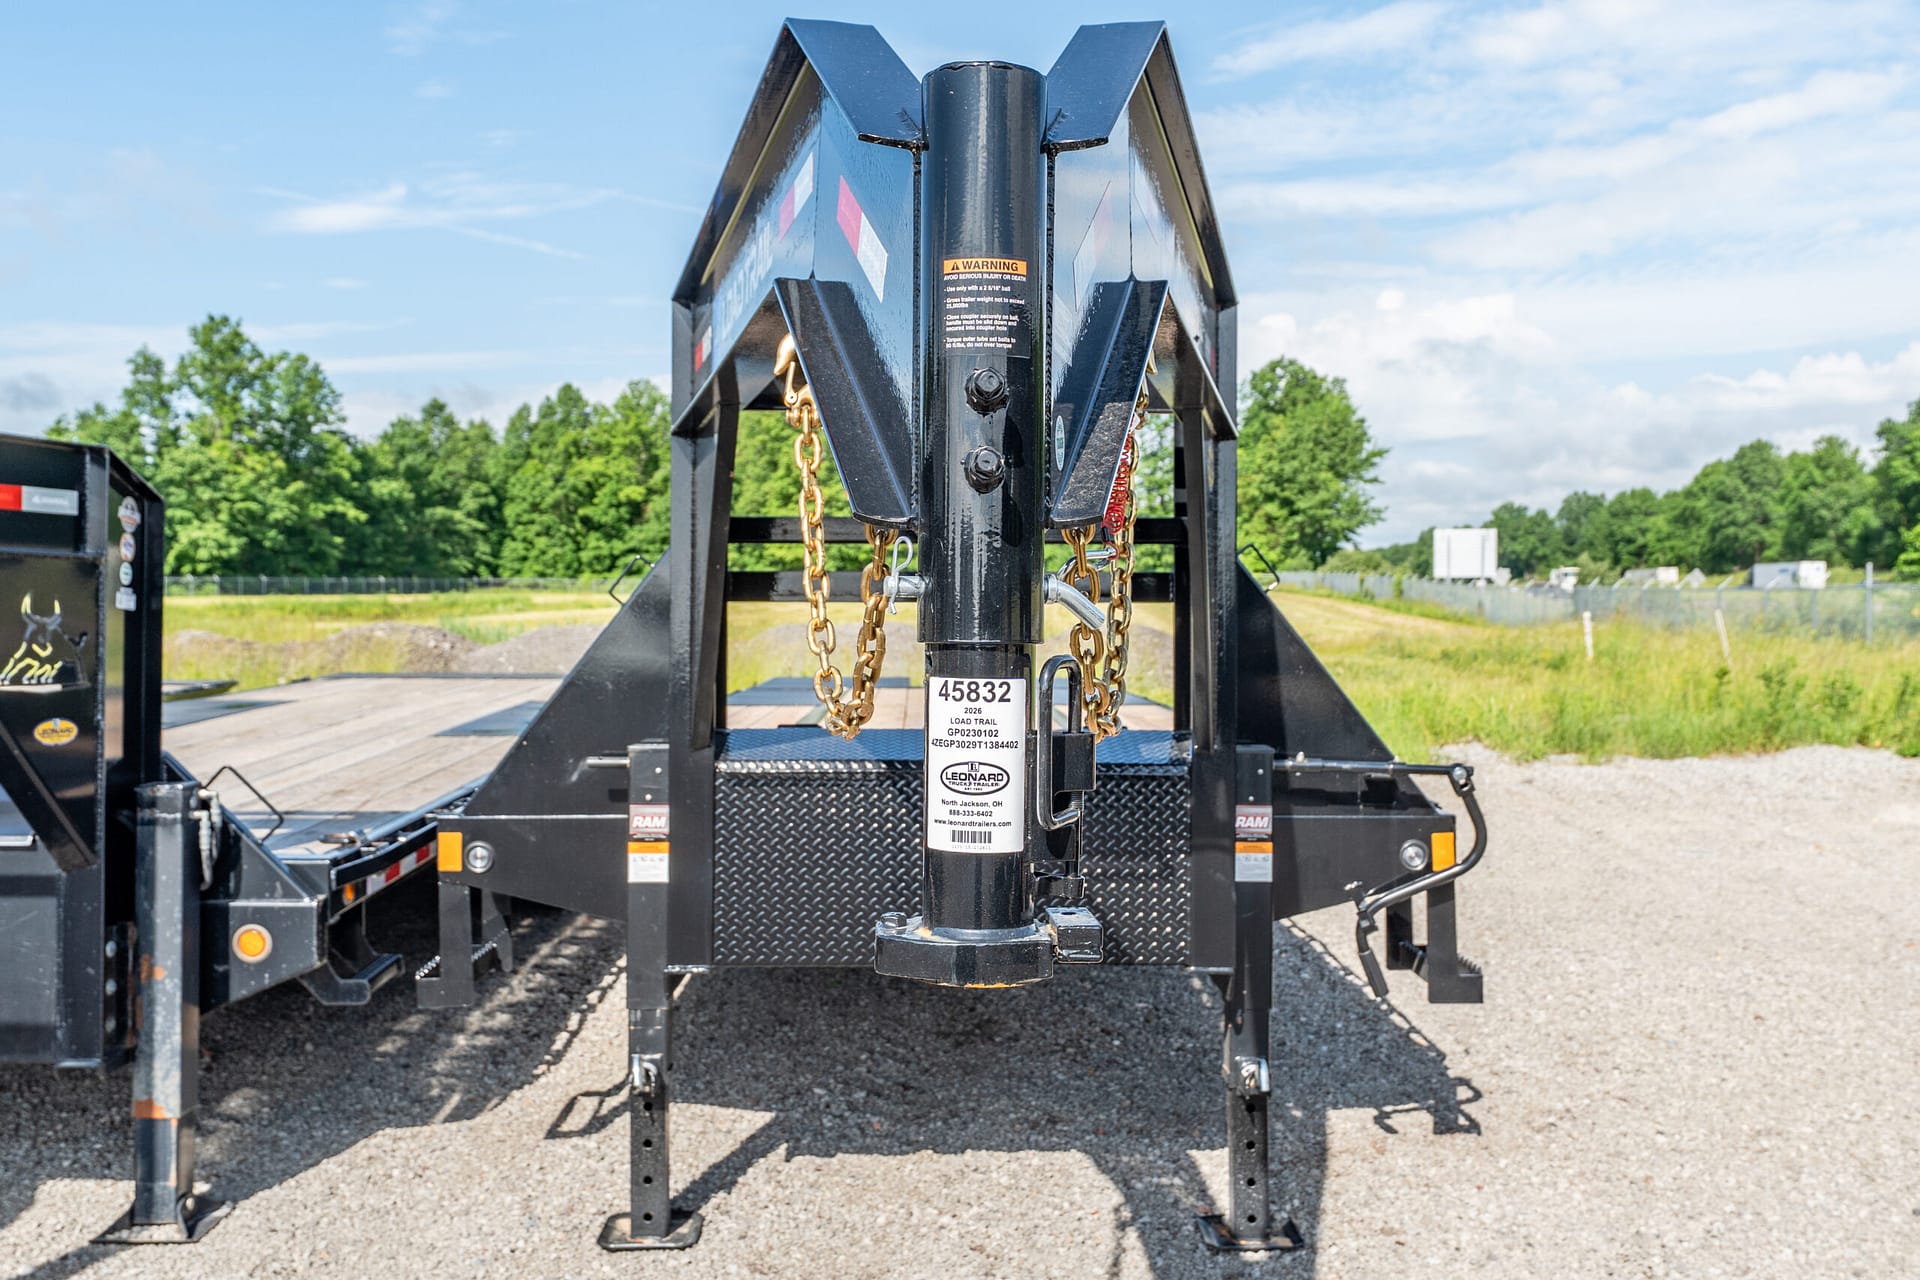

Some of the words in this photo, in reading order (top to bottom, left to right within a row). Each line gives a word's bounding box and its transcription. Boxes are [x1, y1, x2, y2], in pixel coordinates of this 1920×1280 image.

[962, 261, 1018, 272] WARNING
[938, 679, 1012, 703] 45832
[974, 718, 997, 726] TRAIL
[947, 728, 999, 738] GP0230102
[931, 738, 1019, 749] 4ZEGP3029T1384402
[945, 772, 1004, 782] LEONARD
[941, 798, 958, 806] North
[960, 800, 991, 808] Jackson,
[949, 809, 993, 817] 888-333-6402
[632, 816, 666, 828] RAM
[934, 819, 1012, 827] www.leonardtrailers.com
[1235, 816, 1269, 828] RAM
